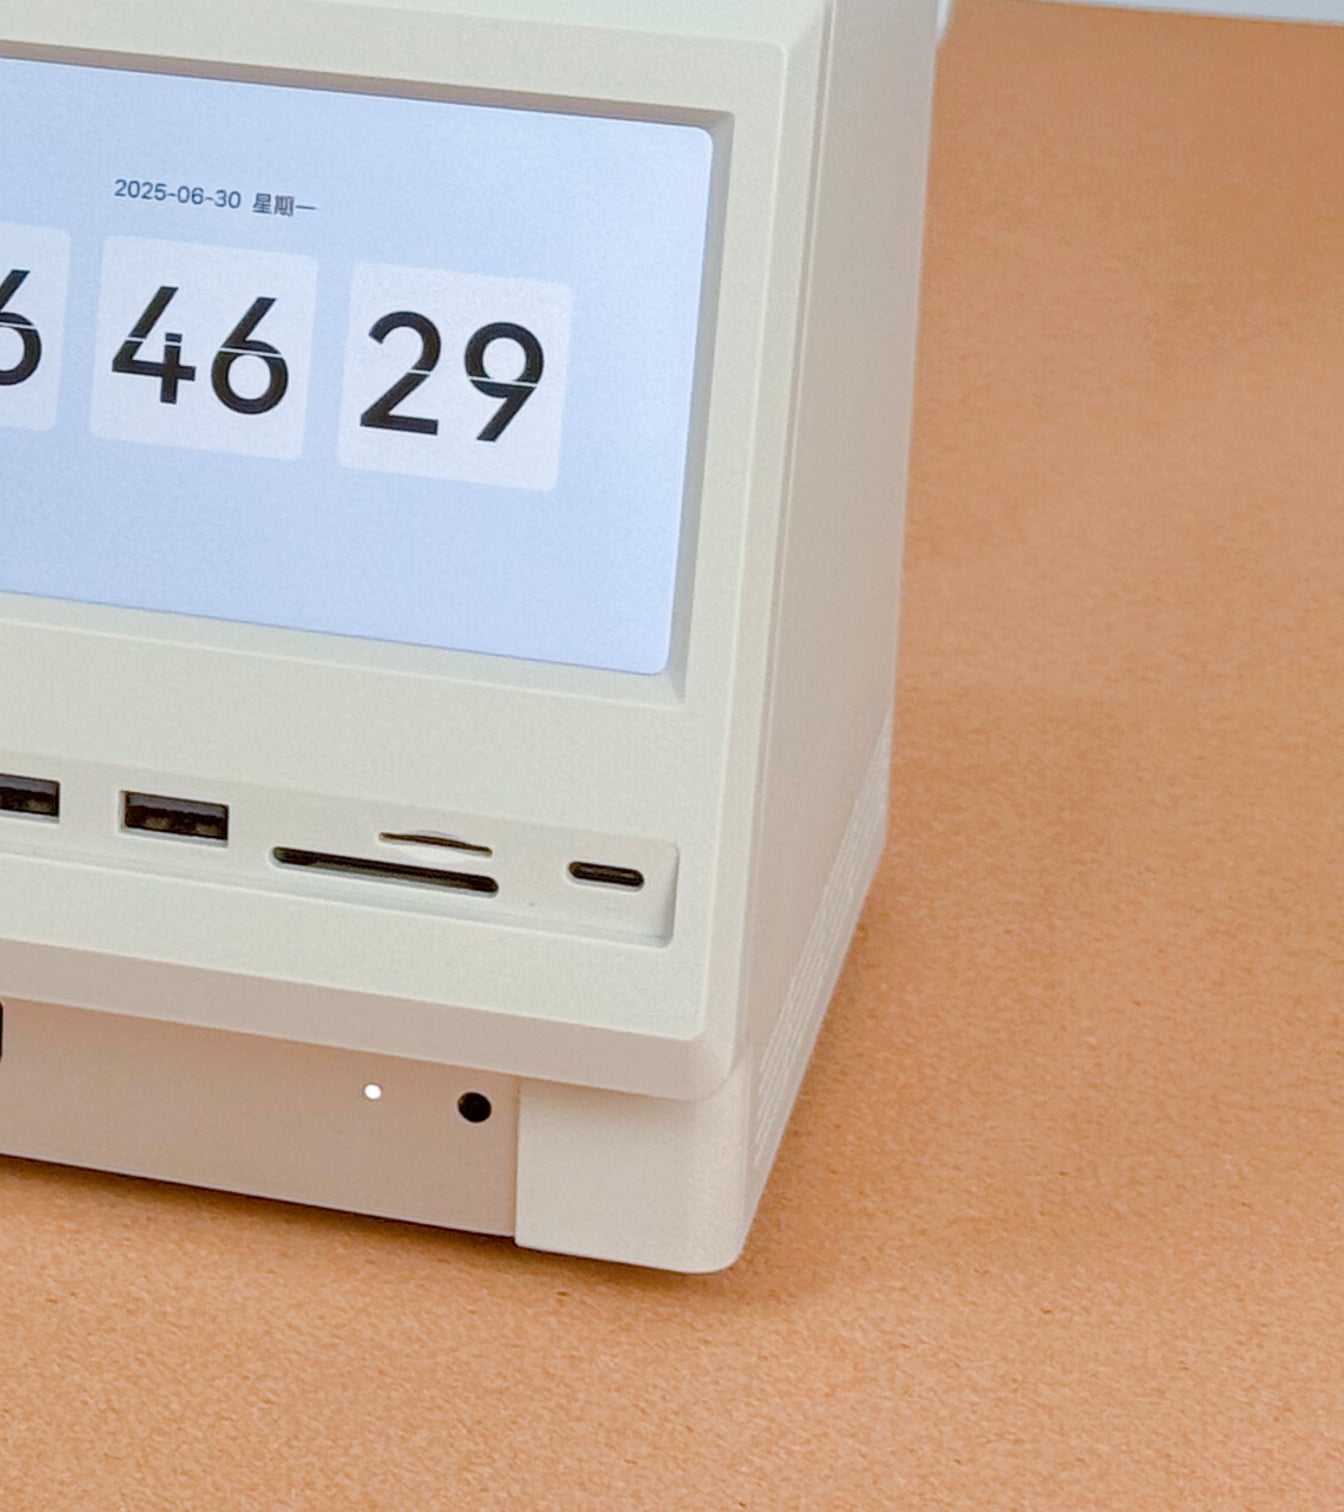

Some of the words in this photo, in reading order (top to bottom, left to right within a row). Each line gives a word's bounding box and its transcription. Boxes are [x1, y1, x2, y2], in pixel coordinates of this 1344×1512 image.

[113, 178, 242, 210] 2025-06-30
[252, 192, 318, 217] 星期一
[112, 285, 289, 415] 46
[360, 310, 545, 443] 29
